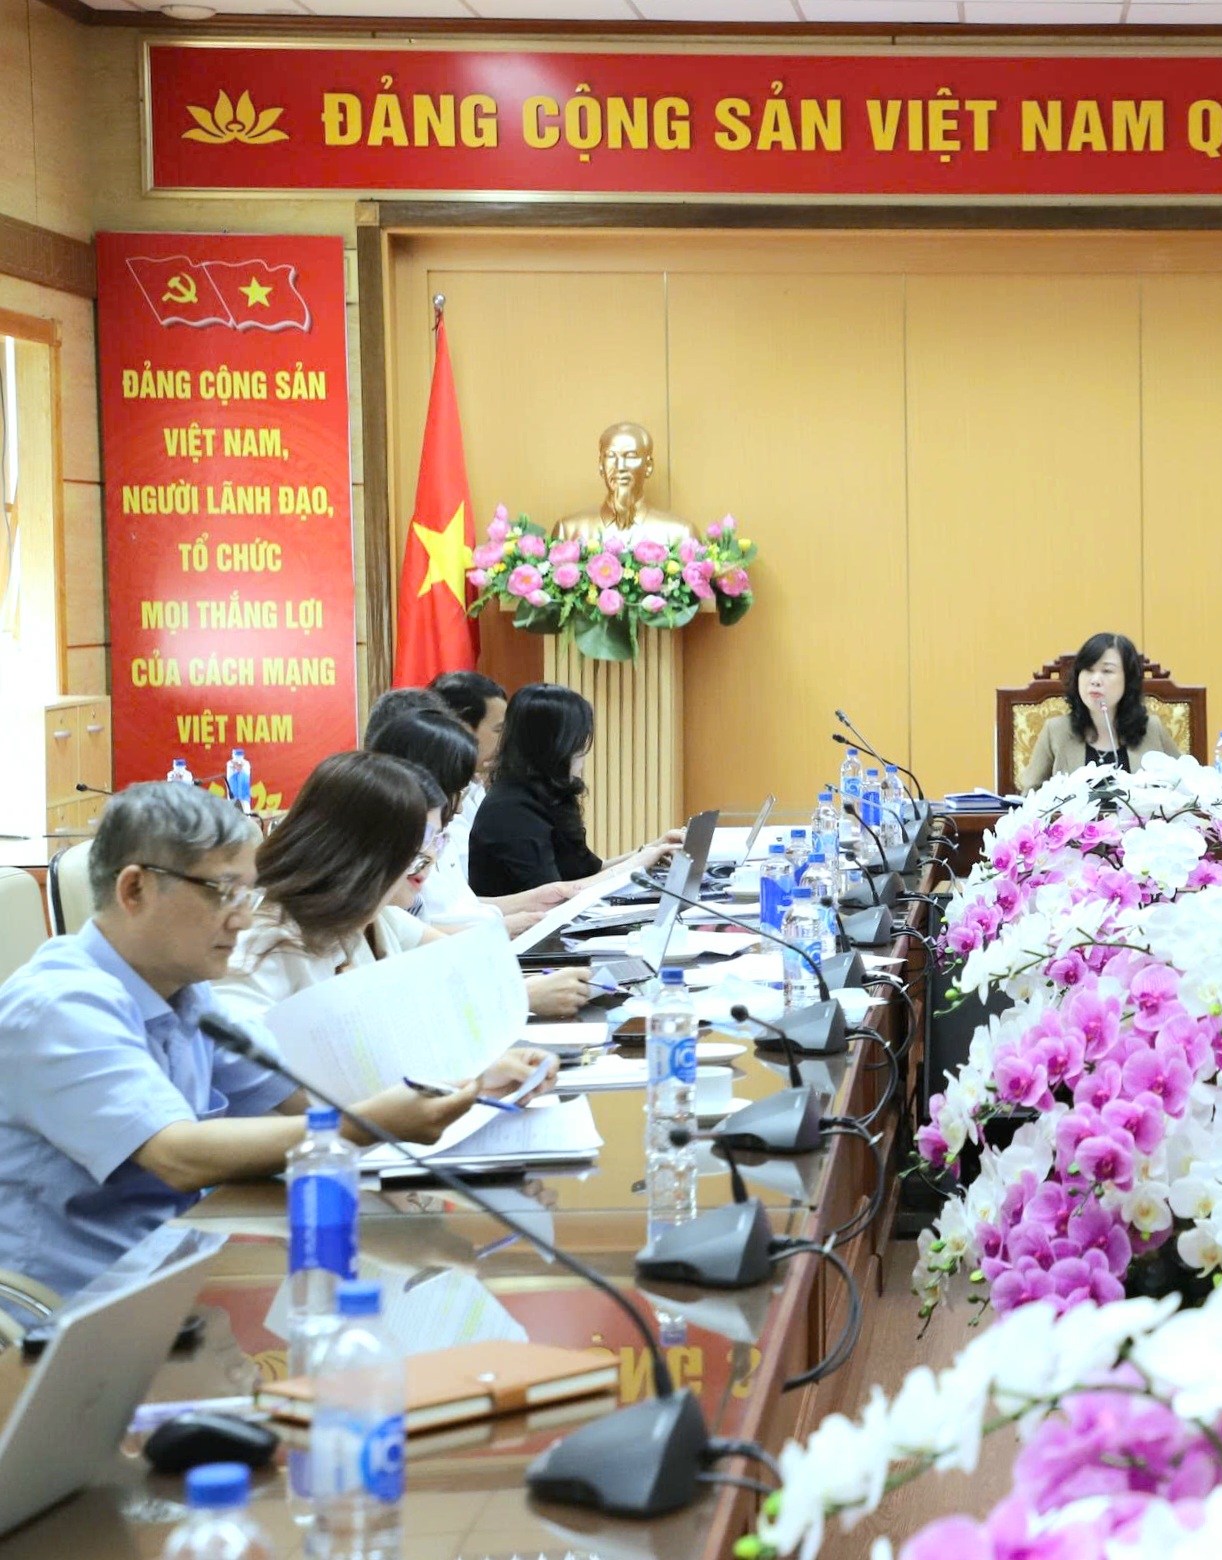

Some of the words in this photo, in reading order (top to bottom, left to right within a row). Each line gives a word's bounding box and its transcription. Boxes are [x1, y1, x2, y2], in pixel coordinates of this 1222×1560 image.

[322, 75, 498, 148] ĐẢNG
[522, 83, 691, 162] CỘNG
[714, 80, 842, 152] SẢN
[866, 88, 997, 163] VIỆT
[1021, 99, 1164, 152] NAM
[122, 361, 191, 400] ĐẢNG
[199, 364, 268, 406] CỘNG
[274, 361, 327, 401] SẢN
[163, 421, 217, 462] VIỆT
[222, 425, 290, 460] NAM,
[122, 482, 200, 516] NGƯỜI
[204, 482, 272, 516] LÃNH
[277, 486, 335, 520] ĐẠO,
[178, 533, 210, 572] TỔ
[216, 536, 283, 573] CHỨC
[140, 600, 189, 635] MỌI
[196, 589, 278, 629] THẮNG
[285, 598, 323, 635] LỢI
[131, 649, 182, 687] CỦA
[188, 652, 254, 686] CÁCH
[261, 657, 336, 692] MẠNG
[176, 709, 230, 750] VIỆT
[235, 713, 294, 745] NAM
[675, 1047, 697, 1068] IC
[370, 1433, 404, 1473] IC
